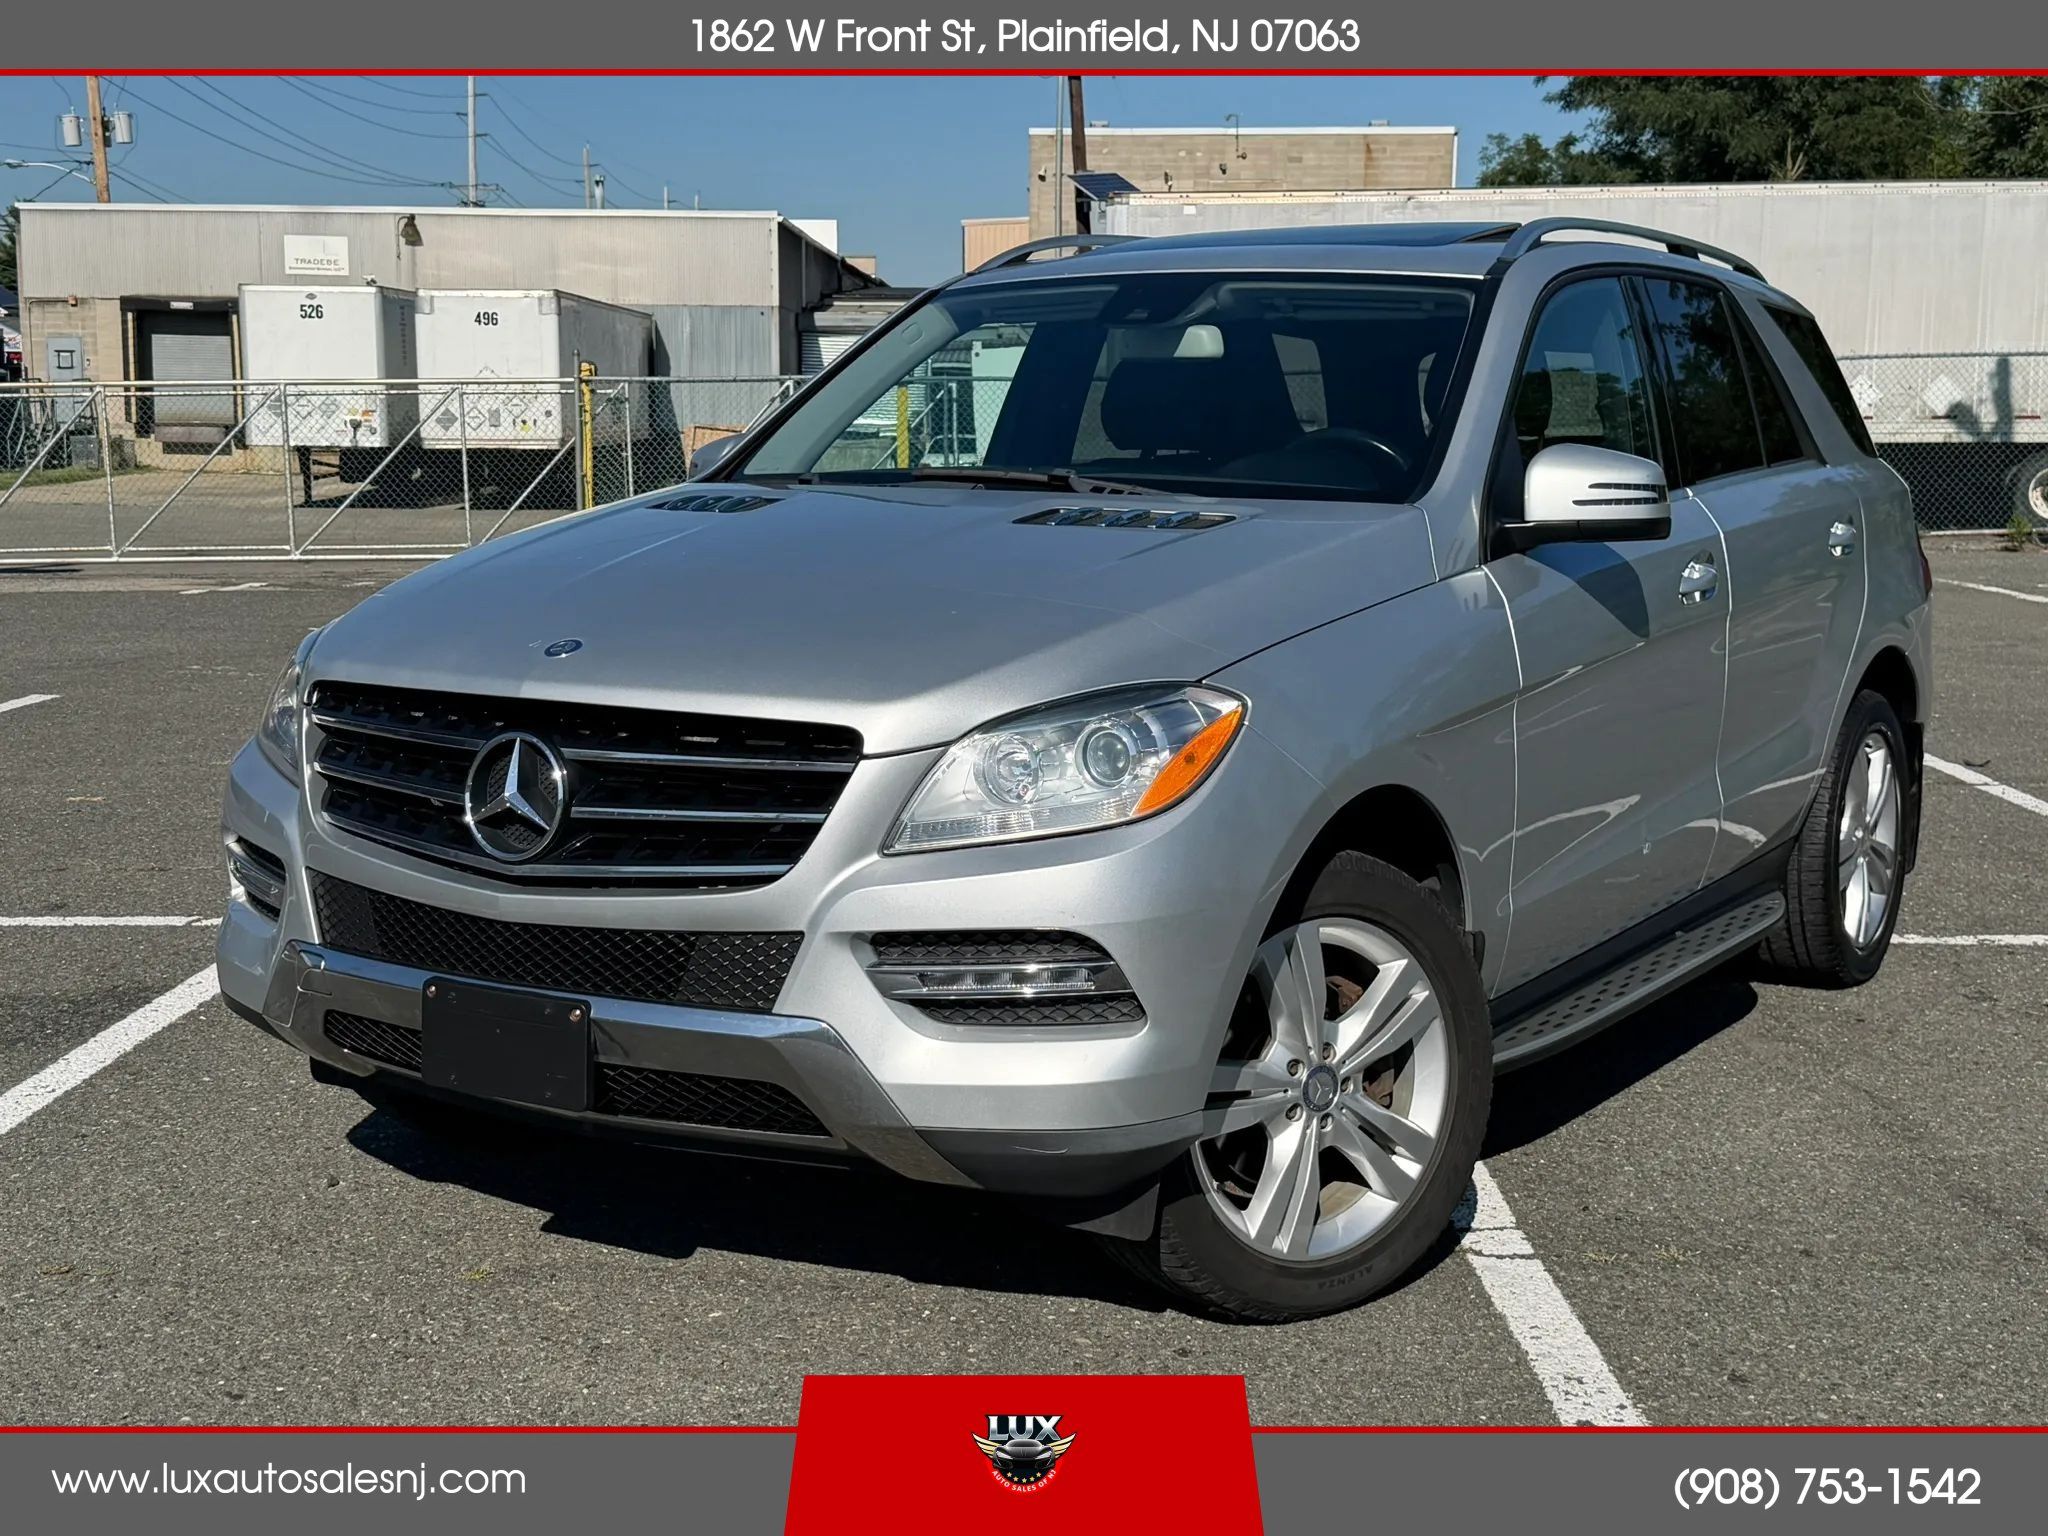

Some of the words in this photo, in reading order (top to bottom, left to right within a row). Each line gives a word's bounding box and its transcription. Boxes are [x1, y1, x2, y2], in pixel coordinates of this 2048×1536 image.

[294, 258, 340, 266] TRADEBE
[299, 304, 324, 320] 526
[474, 311, 499, 327] 496
[1317, 1265, 1373, 1289] ALENZA
